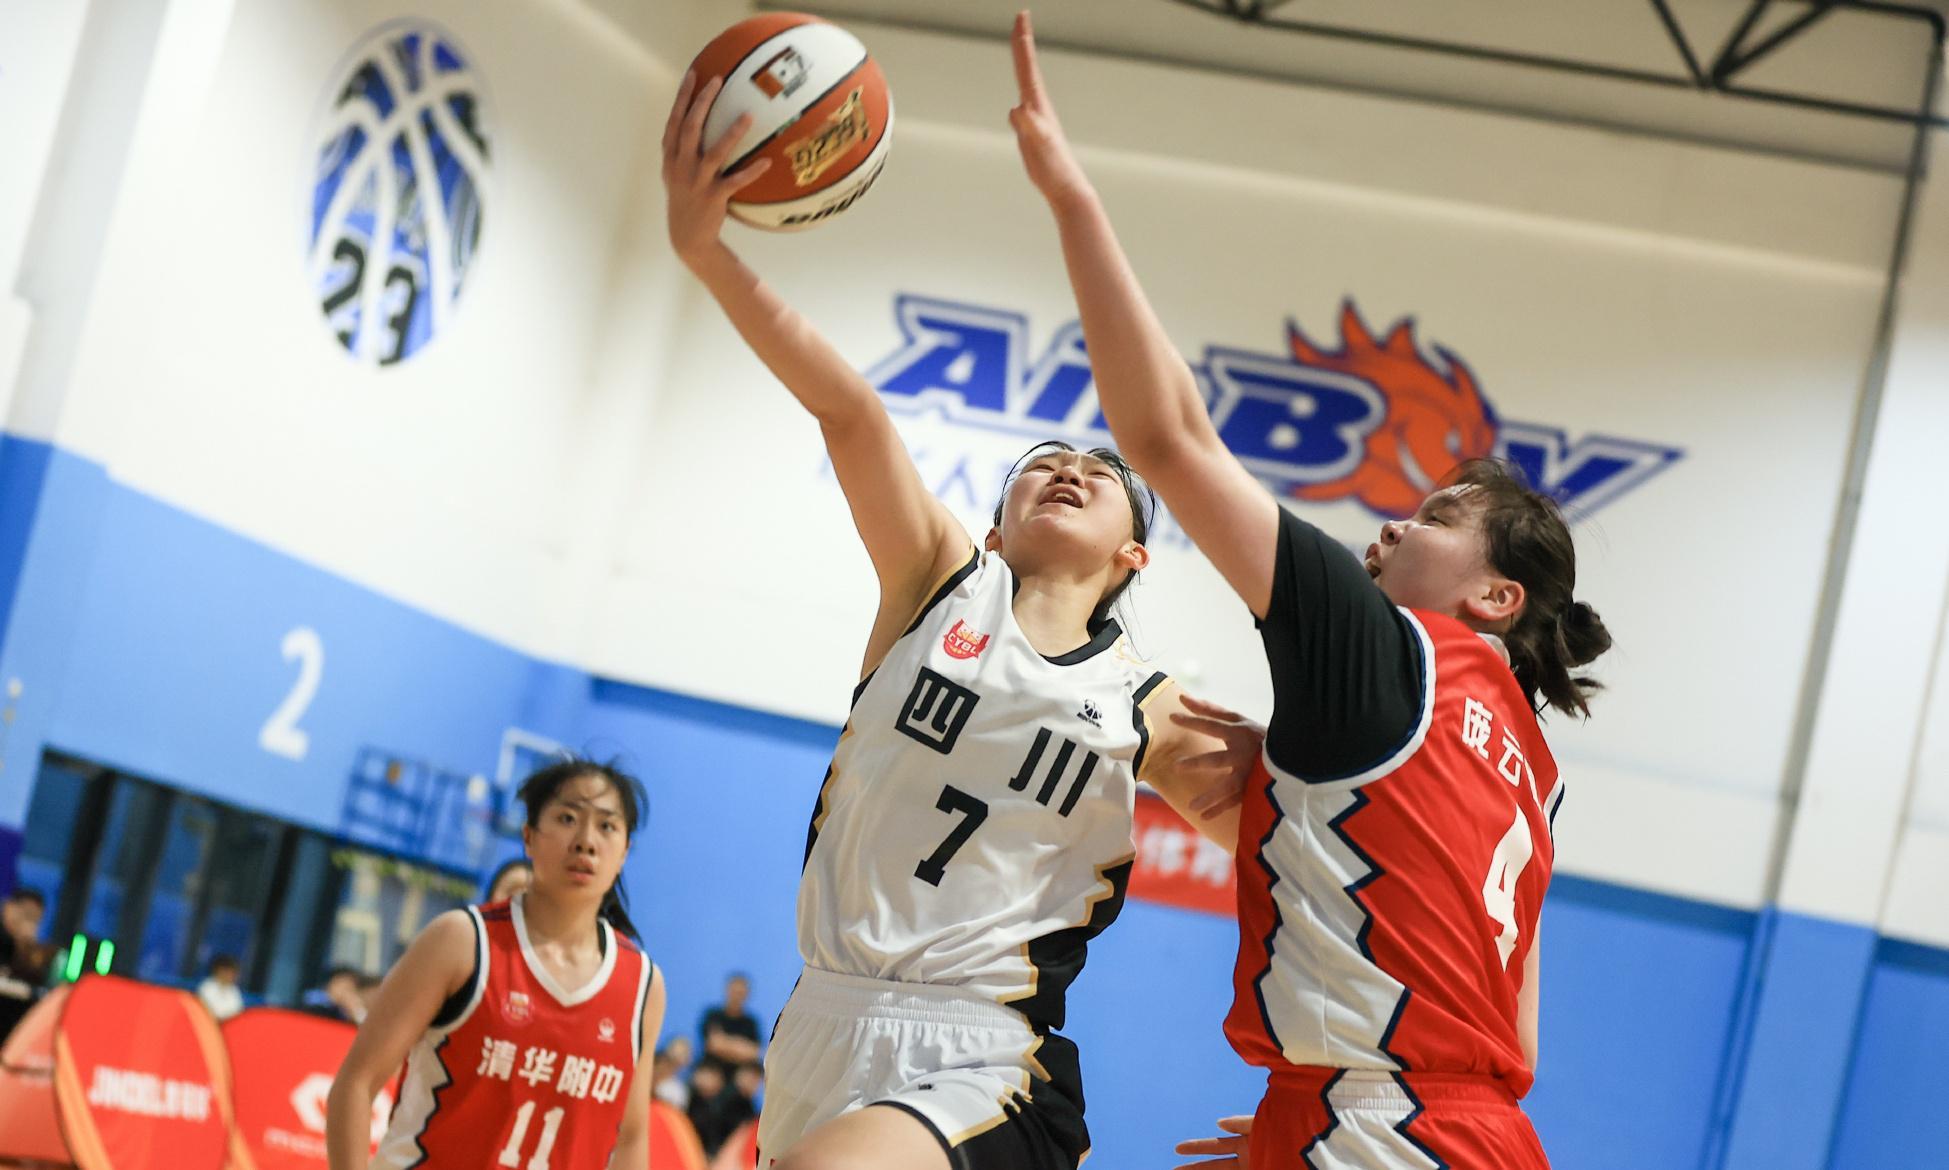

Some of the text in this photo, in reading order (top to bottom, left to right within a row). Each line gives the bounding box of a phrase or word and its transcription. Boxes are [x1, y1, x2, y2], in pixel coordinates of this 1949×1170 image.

[322, 237, 416, 366] 23
[257, 626, 325, 763] 2
[947, 631, 977, 656] CYBL
[894, 666, 1100, 818] 四川
[1461, 696, 1543, 813] 庞云
[913, 784, 989, 887] 7
[1482, 803, 1534, 974] 4
[476, 1035, 625, 1104] 清华附中
[497, 1100, 565, 1170] 11
